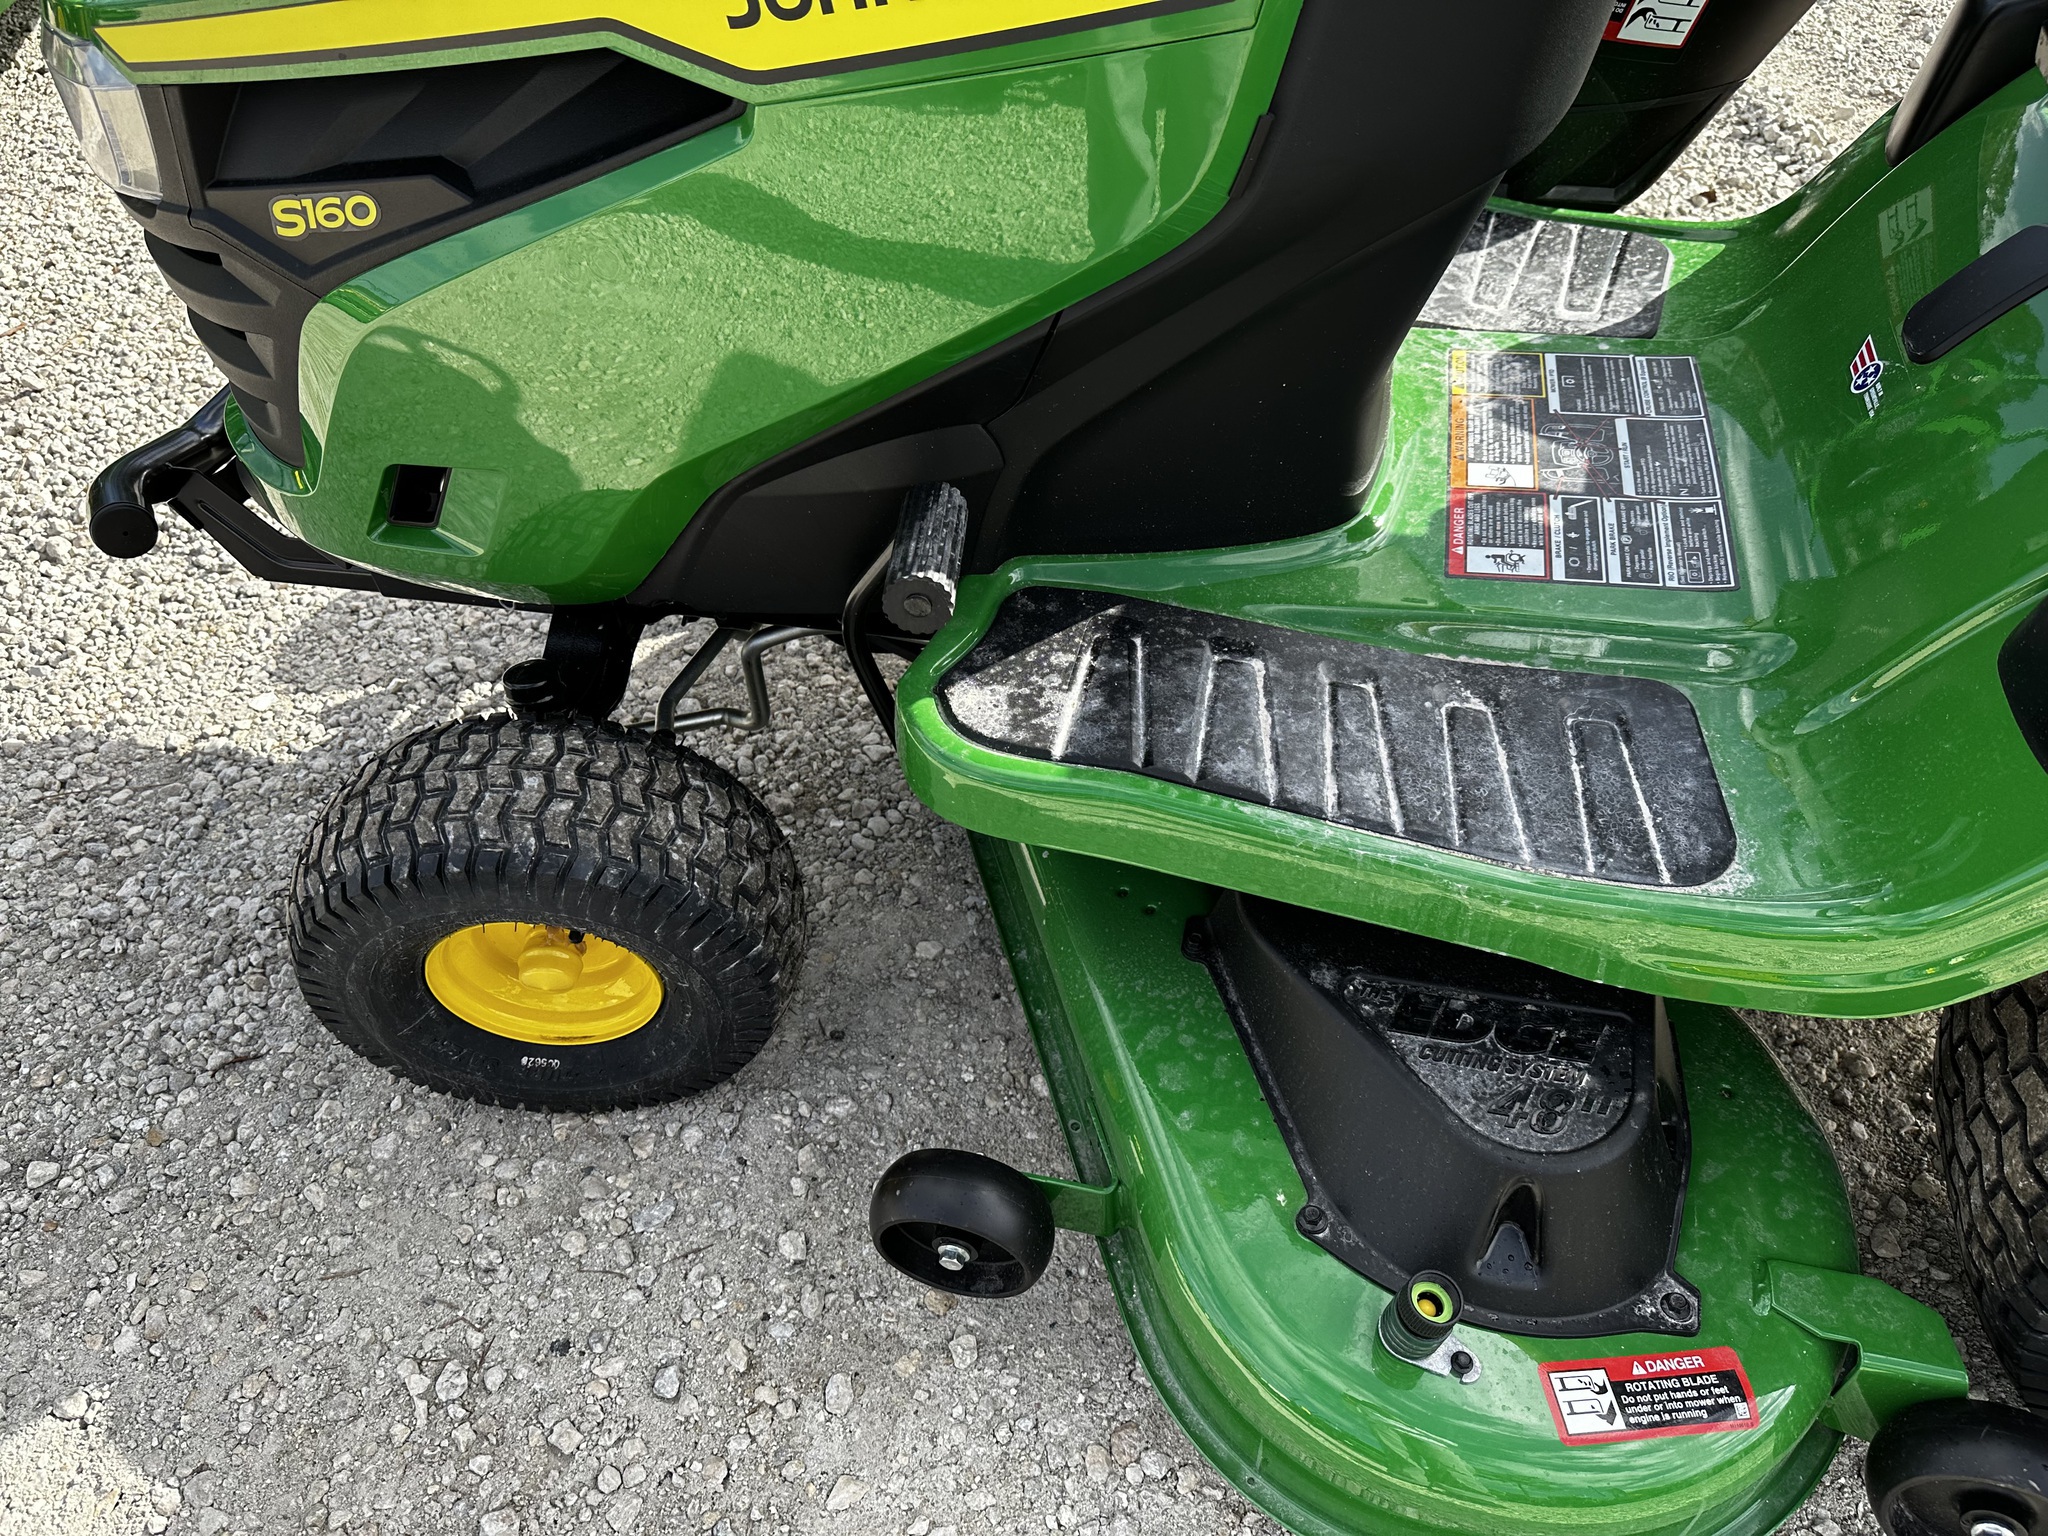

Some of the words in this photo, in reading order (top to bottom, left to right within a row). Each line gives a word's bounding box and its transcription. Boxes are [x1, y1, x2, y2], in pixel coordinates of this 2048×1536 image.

[272, 195, 377, 237] S160
[1641, 382, 1649, 398] CONTROL
[1455, 418, 1464, 452] WARNING
[1660, 505, 1669, 521] Option)
[1453, 508, 1464, 544] DANGER
[1663, 523, 1672, 547] Implement
[1666, 549, 1675, 570] (Reverse
[1419, 1044, 1499, 1072] CUTTING
[1503, 1057, 1588, 1086] SYSTEM
[1645, 1356, 1705, 1373] DANGER
[1624, 1378, 1680, 1393] ROTATING
[1683, 1374, 1719, 1387] BLADE
[1621, 1395, 1633, 1404] Do
[1635, 1393, 1651, 1404] not
[1653, 1391, 1668, 1403] put
[1670, 1388, 1698, 1399] hands
[1700, 1388, 1710, 1396] or
[1711, 1385, 1730, 1395] feet
[1625, 1403, 1651, 1414] under
[1654, 1402, 1664, 1411] or
[1665, 1400, 1681, 1410] into
[1681, 1397, 1716, 1408] mower
[1718, 1395, 1742, 1405] when
[1629, 1412, 1660, 1425] engine
[1662, 1411, 1671, 1421] is
[1672, 1408, 1708, 1421] running
